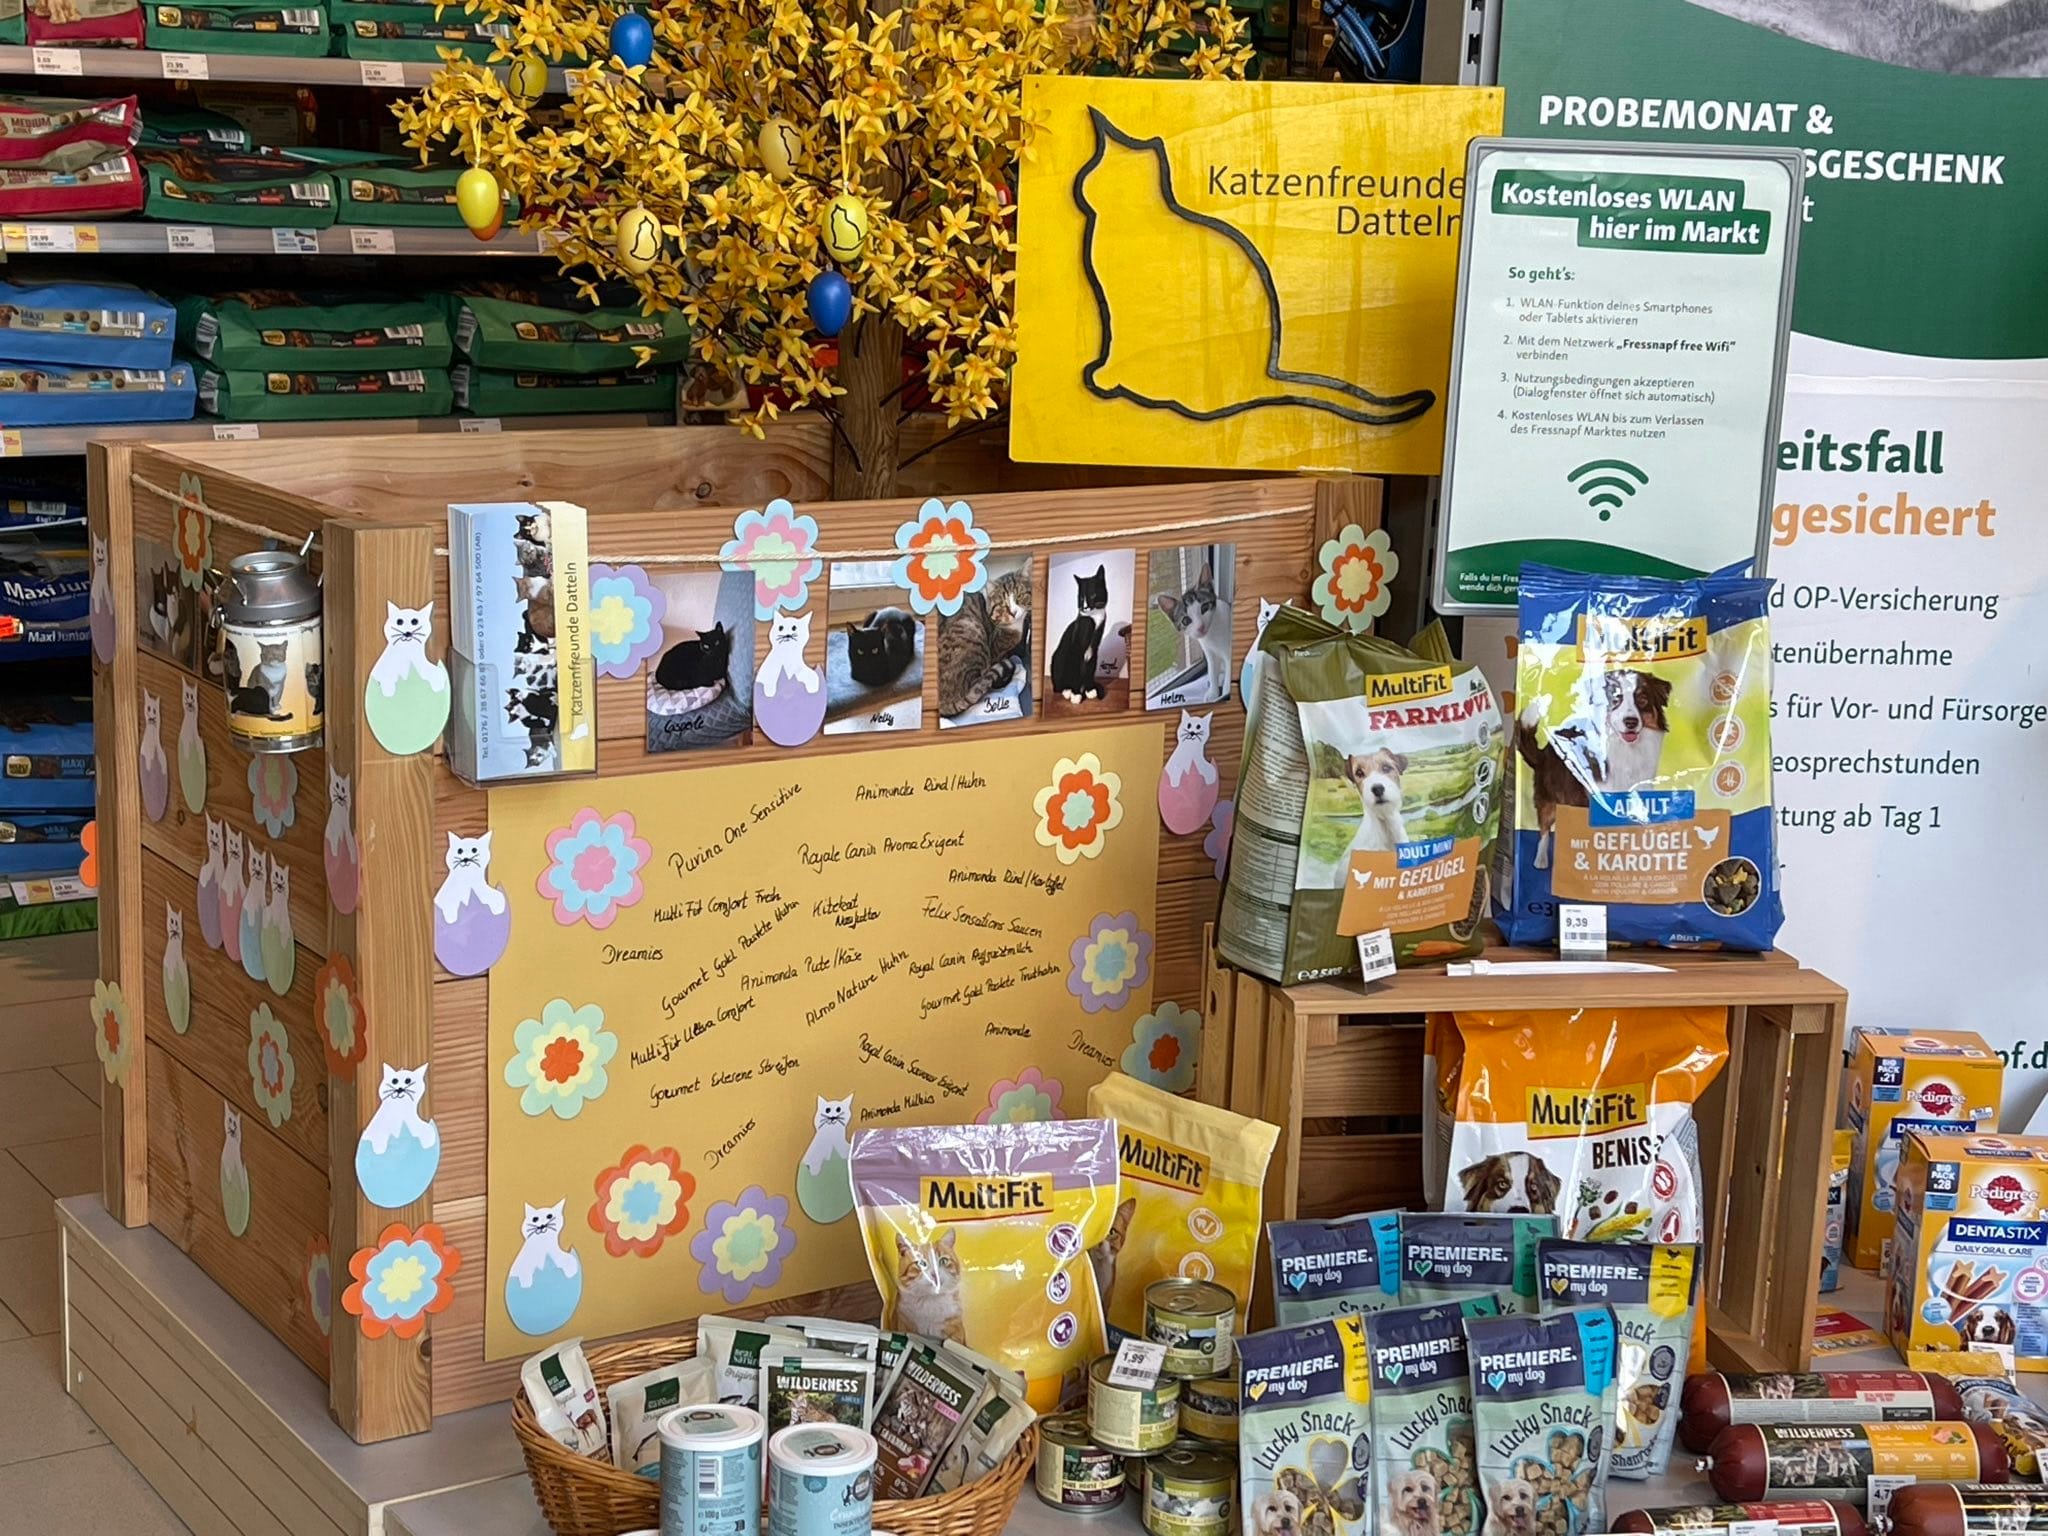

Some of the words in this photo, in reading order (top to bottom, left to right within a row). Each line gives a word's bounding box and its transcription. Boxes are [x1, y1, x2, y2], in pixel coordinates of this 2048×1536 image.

[1539, 95, 1799, 133] PROBEMONAT
[1805, 103, 1835, 136] &
[1208, 165, 1465, 199] Katzenfreunde
[1501, 182, 1652, 210] Kostenloses
[1658, 187, 1736, 213] WLAN
[1589, 215, 1640, 241] hier
[1644, 217, 1677, 242] im
[1681, 219, 1761, 245] Markt
[1508, 267, 1526, 280] So
[1505, 297, 1515, 308] 1.
[1520, 297, 1604, 311] WLAN-Funktion
[1606, 298, 1641, 312] deines
[1643, 300, 1713, 316] Smartphones
[1519, 312, 1544, 323] oder
[1545, 312, 1584, 325] Tablets
[1585, 313, 1639, 327] aktivieren
[1502, 335, 1513, 346] 2.
[1517, 335, 1538, 347] Mit
[1539, 336, 1561, 347] dem
[1563, 336, 1614, 349] Netzwerk
[1680, 340, 1704, 352] free
[1516, 350, 1569, 362] verbinden
[1500, 372, 1511, 384] 3.
[1514, 372, 1631, 390] Nutzungsbedingungen
[1633, 377, 1695, 390] akzeptieren
[1512, 386, 1587, 402] (Dialogfenster
[1589, 387, 1622, 401] öffnet
[1624, 389, 1647, 402] sich
[1647, 390, 1717, 406] automatisch)
[1511, 410, 1574, 423] Kostenloses
[1576, 412, 1611, 424] WLAN
[1612, 413, 1629, 424] bis
[1629, 416, 1652, 426] zum
[1654, 414, 1706, 427] Verlassen
[1510, 424, 1529, 436] des
[1530, 425, 1583, 440] Fressnapf
[1584, 426, 1628, 439] Marktes
[1629, 428, 1667, 440] nutzen
[1771, 491, 1997, 547] gesichert
[4, 579, 56, 601] Maxi
[563, 562, 581, 613] Datteln
[1794, 585, 2000, 619] OP-Versicherung
[28, 630, 56, 643] Maxi
[1772, 639, 1954, 667] tenübernahme
[564, 617, 585, 717] Katzenfreunde
[1370, 673, 1449, 700] MultiFit
[1787, 693, 1823, 718] für
[1830, 696, 1879, 721] Vor-
[1888, 695, 1933, 721] und
[1942, 698, 2048, 730] Fürsorge
[667, 845, 723, 879] Purina
[724, 822, 747, 845] One
[751, 782, 803, 824] Sensitive
[1844, 803, 1872, 829] ab
[1881, 805, 1923, 836] Tag
[1929, 806, 1942, 829] 1
[1570, 838, 1590, 849] MIT
[1592, 829, 1693, 852] GEFLÜGEL
[845, 842, 878, 862] Canin
[1399, 846, 1431, 861] ADULT
[1574, 852, 1590, 871] &
[1597, 852, 1689, 872] KAROTTE
[1373, 875, 1397, 892] MIT
[1399, 855, 1467, 888] GEFLÜGEL
[922, 896, 951, 920] Felix
[602, 944, 664, 965] Dreamies
[836, 973, 878, 1004] Nature
[878, 949, 909, 975] Huhn
[1531, 1091, 1638, 1125] MultiFit
[1906, 1090, 1966, 1108] Pedigree
[1119, 1133, 1205, 1189] MultiFit
[928, 1180, 1045, 1210] MultiFit
[1970, 1184, 2039, 1206] Pedigree
[1955, 1224, 2042, 1240] DENTASTIX
[1954, 1244, 1981, 1254] DAILY
[1982, 1246, 2007, 1255] ORAL
[2008, 1247, 2033, 1256] CARE
[1309, 1271, 1325, 1286] my
[1325, 1268, 1342, 1283] dog
[1434, 1264, 1452, 1278] my
[1452, 1262, 1473, 1278] dog
[1569, 1284, 1588, 1297] my
[1589, 1279, 1608, 1297] dog
[1404, 1362, 1420, 1377] my
[1420, 1358, 1438, 1375] dog
[1508, 1372, 1524, 1387] my
[1524, 1368, 1546, 1385] dog
[776, 1375, 859, 1393] WILDERNESS
[905, 1360, 962, 1407] WILDERNESS
[1268, 1380, 1286, 1396] my
[1286, 1377, 1308, 1394] dog
[1252, 1422, 1300, 1471] Lucky
[1301, 1410, 1356, 1436] Snack
[1389, 1411, 1440, 1451] Lucky
[1489, 1413, 1540, 1459] Lucky
[1541, 1401, 1594, 1429] Snack
[1774, 1427, 1856, 1441] WILDERNESS
